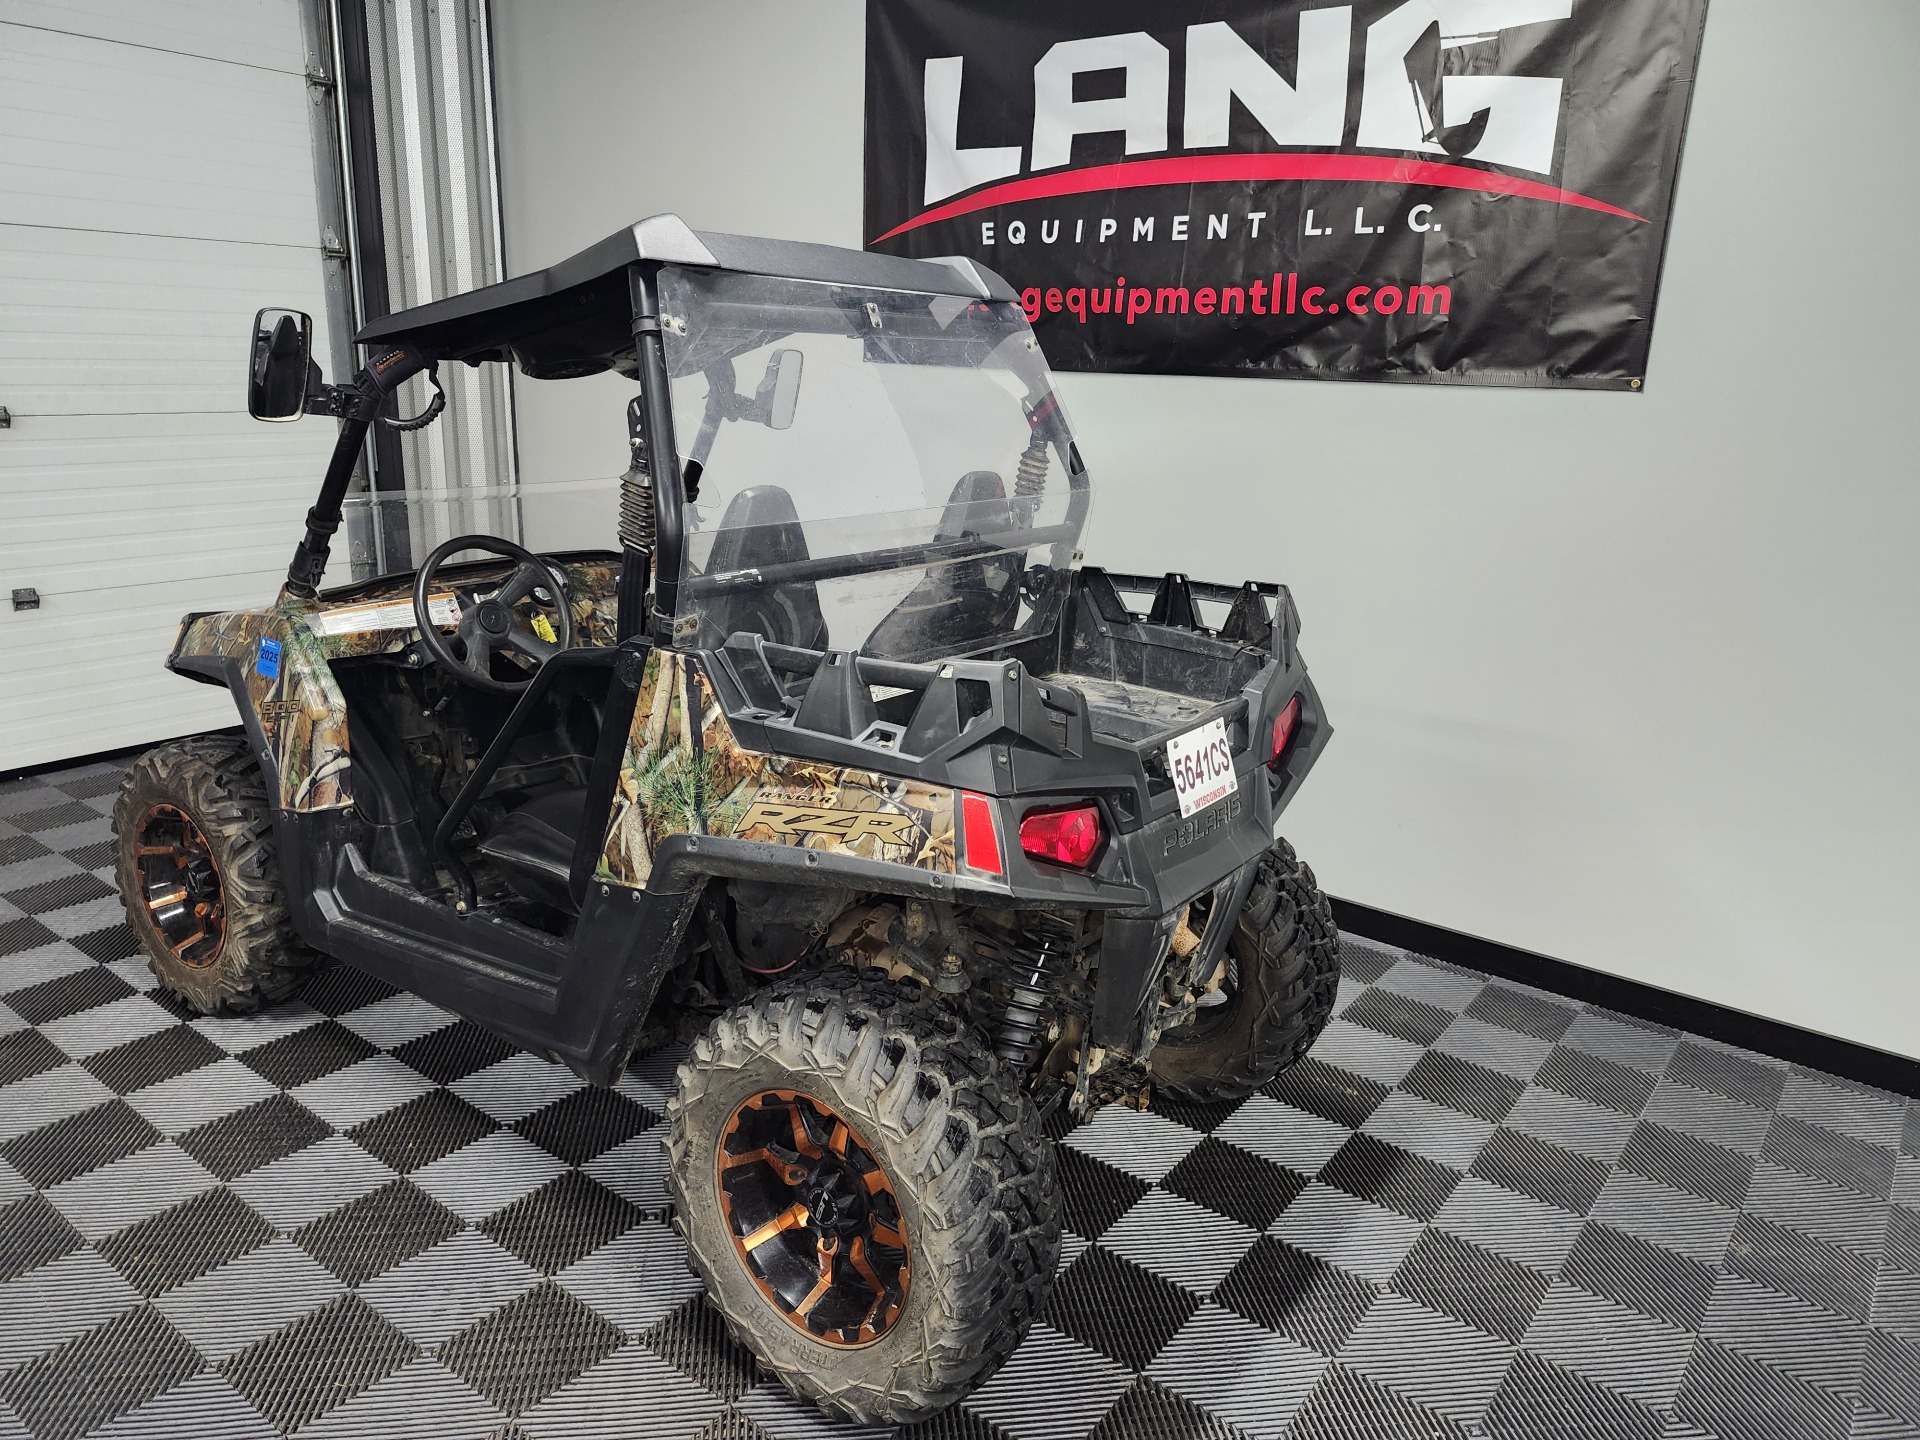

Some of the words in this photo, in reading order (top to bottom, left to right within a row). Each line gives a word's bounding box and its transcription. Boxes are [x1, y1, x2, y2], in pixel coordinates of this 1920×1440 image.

[924, 0, 1573, 205] LANG
[981, 211, 1267, 245] EQUIPMENT
[968, 272, 1452, 325] gequipmentllc.com
[260, 648, 279, 664] 2025
[1174, 737, 1230, 794] 5641CS
[759, 790, 834, 804] RANGER
[1193, 784, 1227, 810] WISCONSIN
[732, 801, 915, 848] RZR
[1163, 793, 1242, 857] POLARIS
